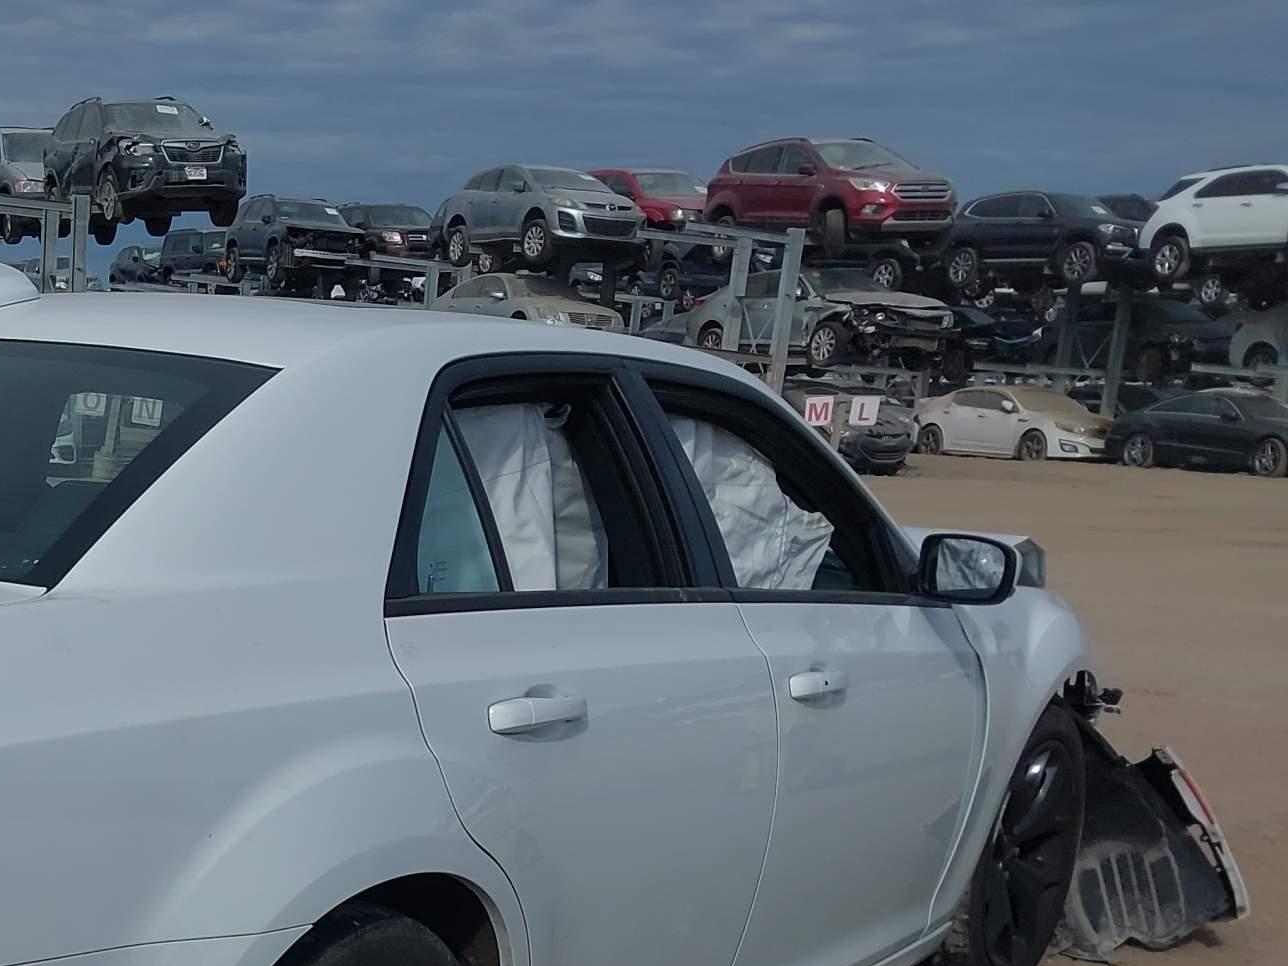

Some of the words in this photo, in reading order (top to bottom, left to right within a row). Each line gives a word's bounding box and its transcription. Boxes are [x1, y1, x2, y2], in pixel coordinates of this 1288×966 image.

[138, 400, 157, 420] N
[808, 402, 830, 422] M
[858, 402, 871, 422] L
